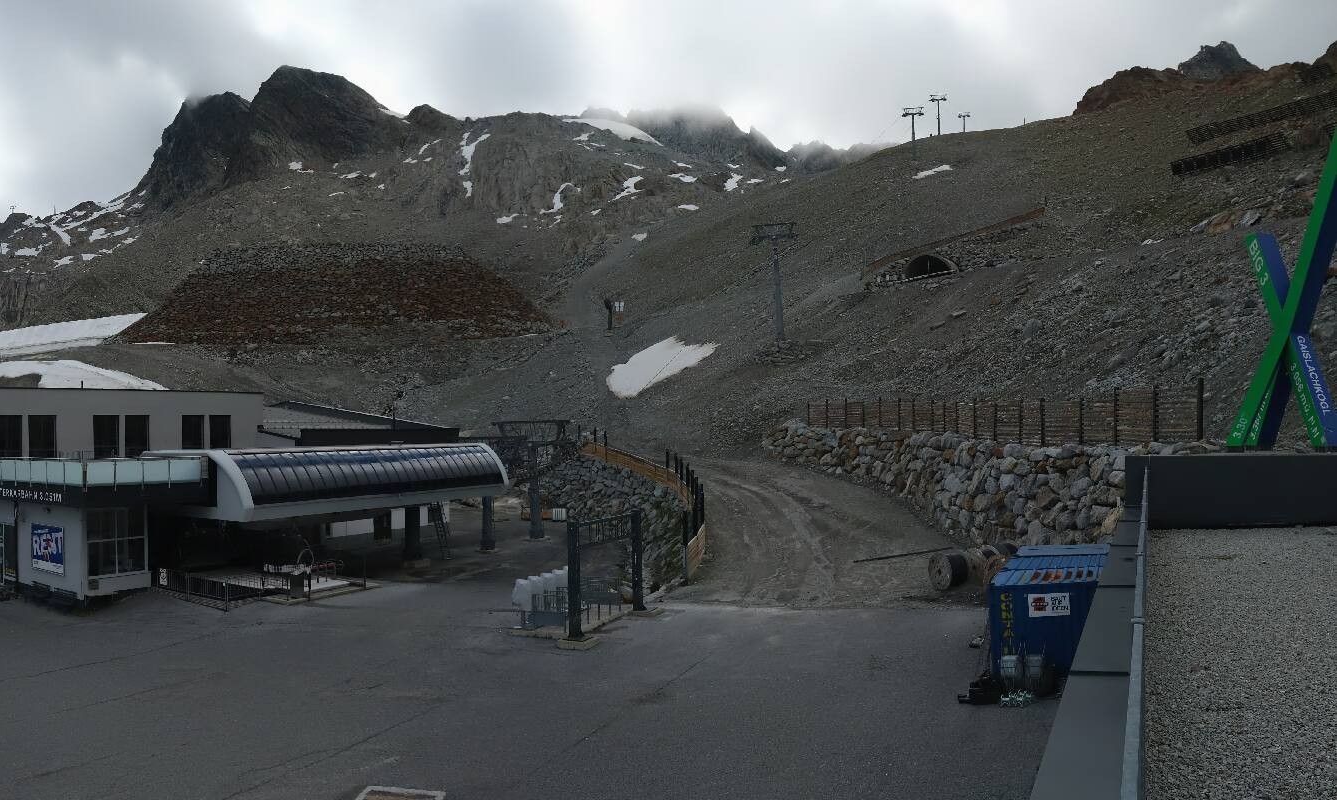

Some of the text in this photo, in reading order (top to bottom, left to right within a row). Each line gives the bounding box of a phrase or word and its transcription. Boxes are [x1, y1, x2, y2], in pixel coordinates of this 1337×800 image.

[1249, 238, 1269, 286] BIG 3
[1296, 335, 1331, 416] GAISLACHKOGL
